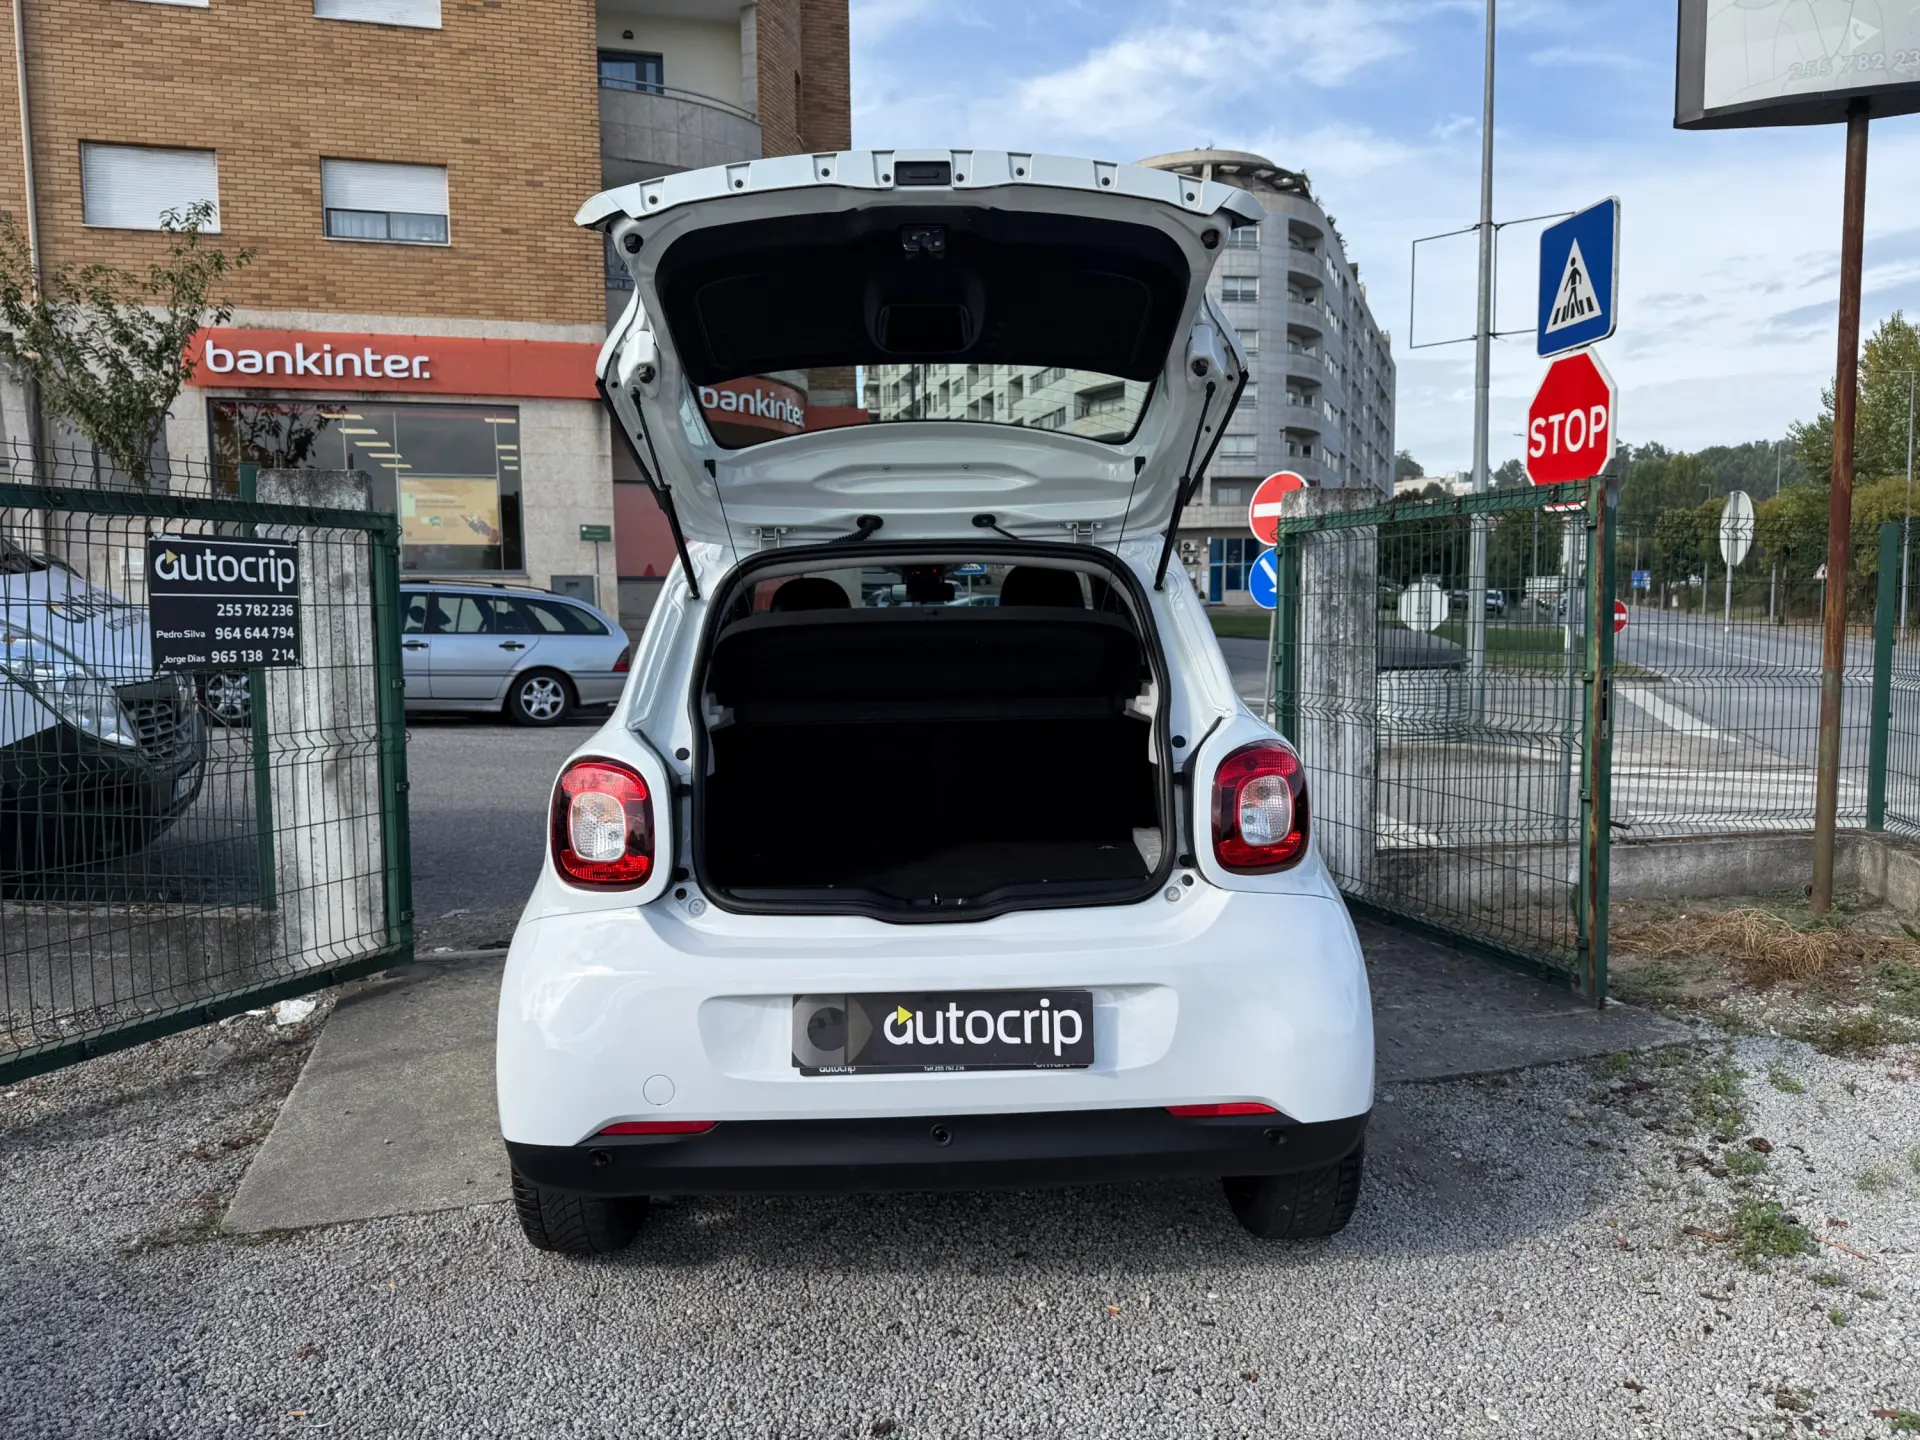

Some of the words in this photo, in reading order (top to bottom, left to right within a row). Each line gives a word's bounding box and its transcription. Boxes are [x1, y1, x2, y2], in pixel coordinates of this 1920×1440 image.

[1789, 59, 1834, 81] 255
[1841, 51, 1886, 74] 782
[1529, 404, 1607, 458] STOP
[154, 548, 296, 592] autocrip
[217, 604, 243, 617] 255
[244, 604, 269, 617] 782
[271, 604, 294, 617] 236
[156, 630, 183, 639] Pedro
[183, 629, 206, 639] Silva
[215, 627, 242, 640] 964
[244, 627, 269, 640] 644
[271, 626, 295, 639] 794
[163, 655, 187, 665] Jorge
[187, 654, 206, 663] Dias
[211, 650, 237, 663] 965
[241, 650, 263, 662] 138
[271, 648, 296, 661] 214
[883, 998, 1083, 1057] autocrip
